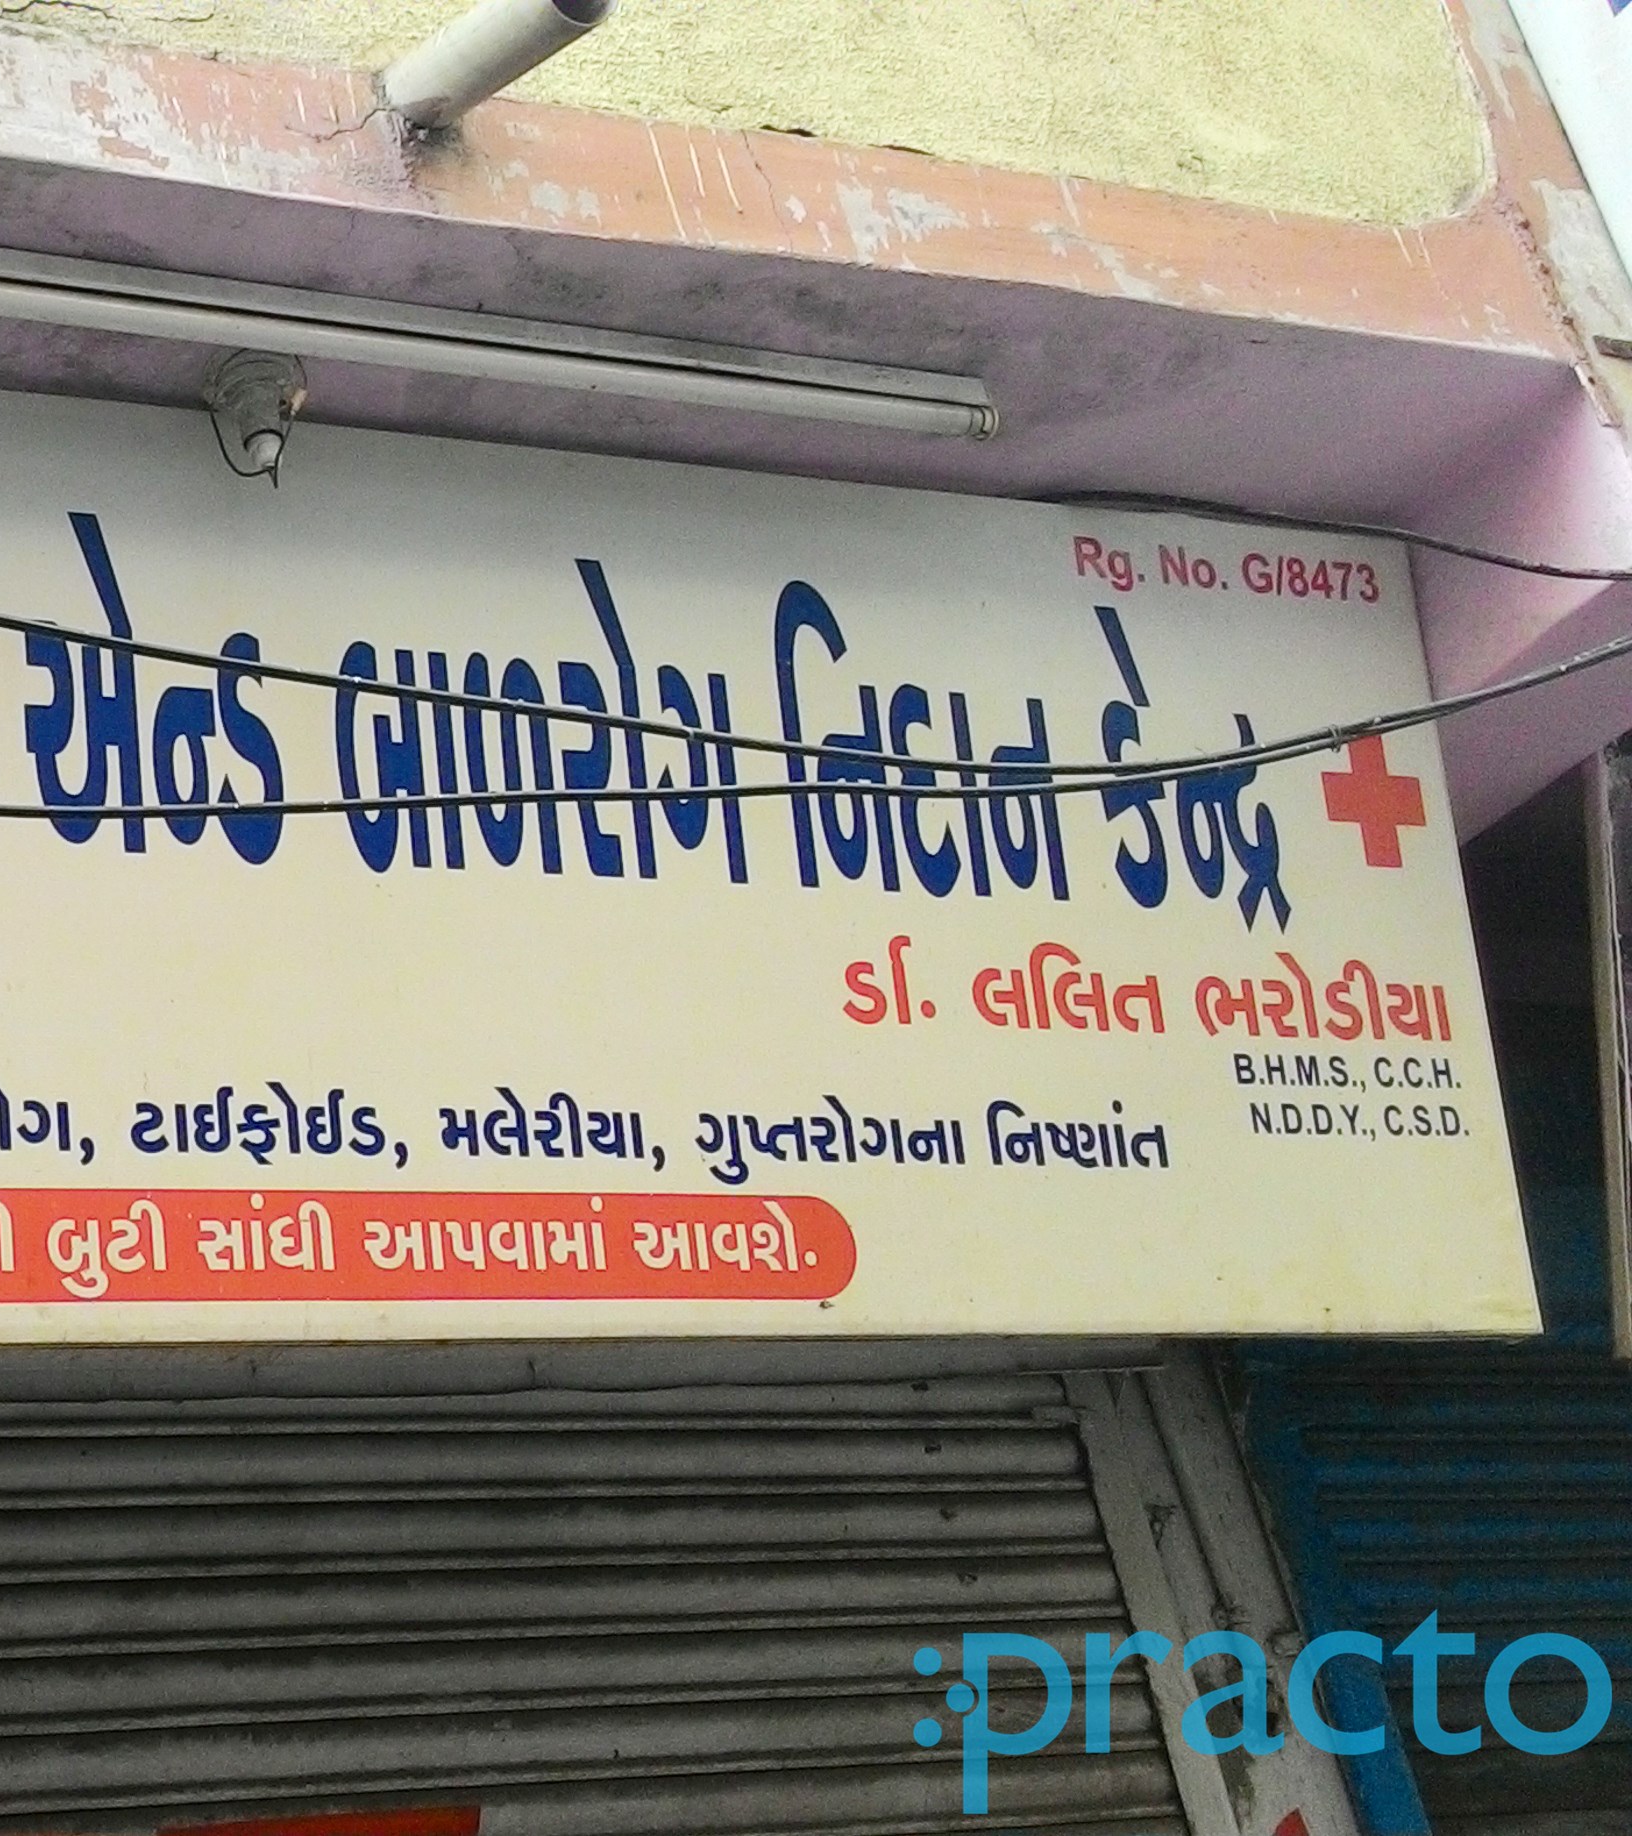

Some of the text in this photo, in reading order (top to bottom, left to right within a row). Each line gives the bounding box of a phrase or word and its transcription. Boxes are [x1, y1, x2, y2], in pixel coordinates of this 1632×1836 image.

[1074, 537, 1380, 604] Rg. No. G/8473
[24, 511, 283, 865] એન્ડ
[335, 558, 749, 885] બાળરોગ
[774, 580, 1070, 901] નિદાન
[1094, 605, 1292, 933] કેન્દ્ર
[972, 942, 1165, 1033] લલિત
[1196, 952, 1450, 1040] ભરોડીયા
[1232, 1053, 1462, 1093] B.H.M.S., C.C.H.
[1249, 1102, 1470, 1142] N.D.D.Y., C.S.D.
[440, 1087, 665, 1171] મલેરીયા,
[696, 1095, 965, 1185] ગુપ્તરોગના
[987, 1100, 1168, 1168] નિષ્ણાંત
[48, 1200, 166, 1298] બુટી
[198, 1194, 334, 1270] સાંધી
[365, 1197, 605, 1269] આપવામાં
[634, 1202, 816, 1270] આવશે.
